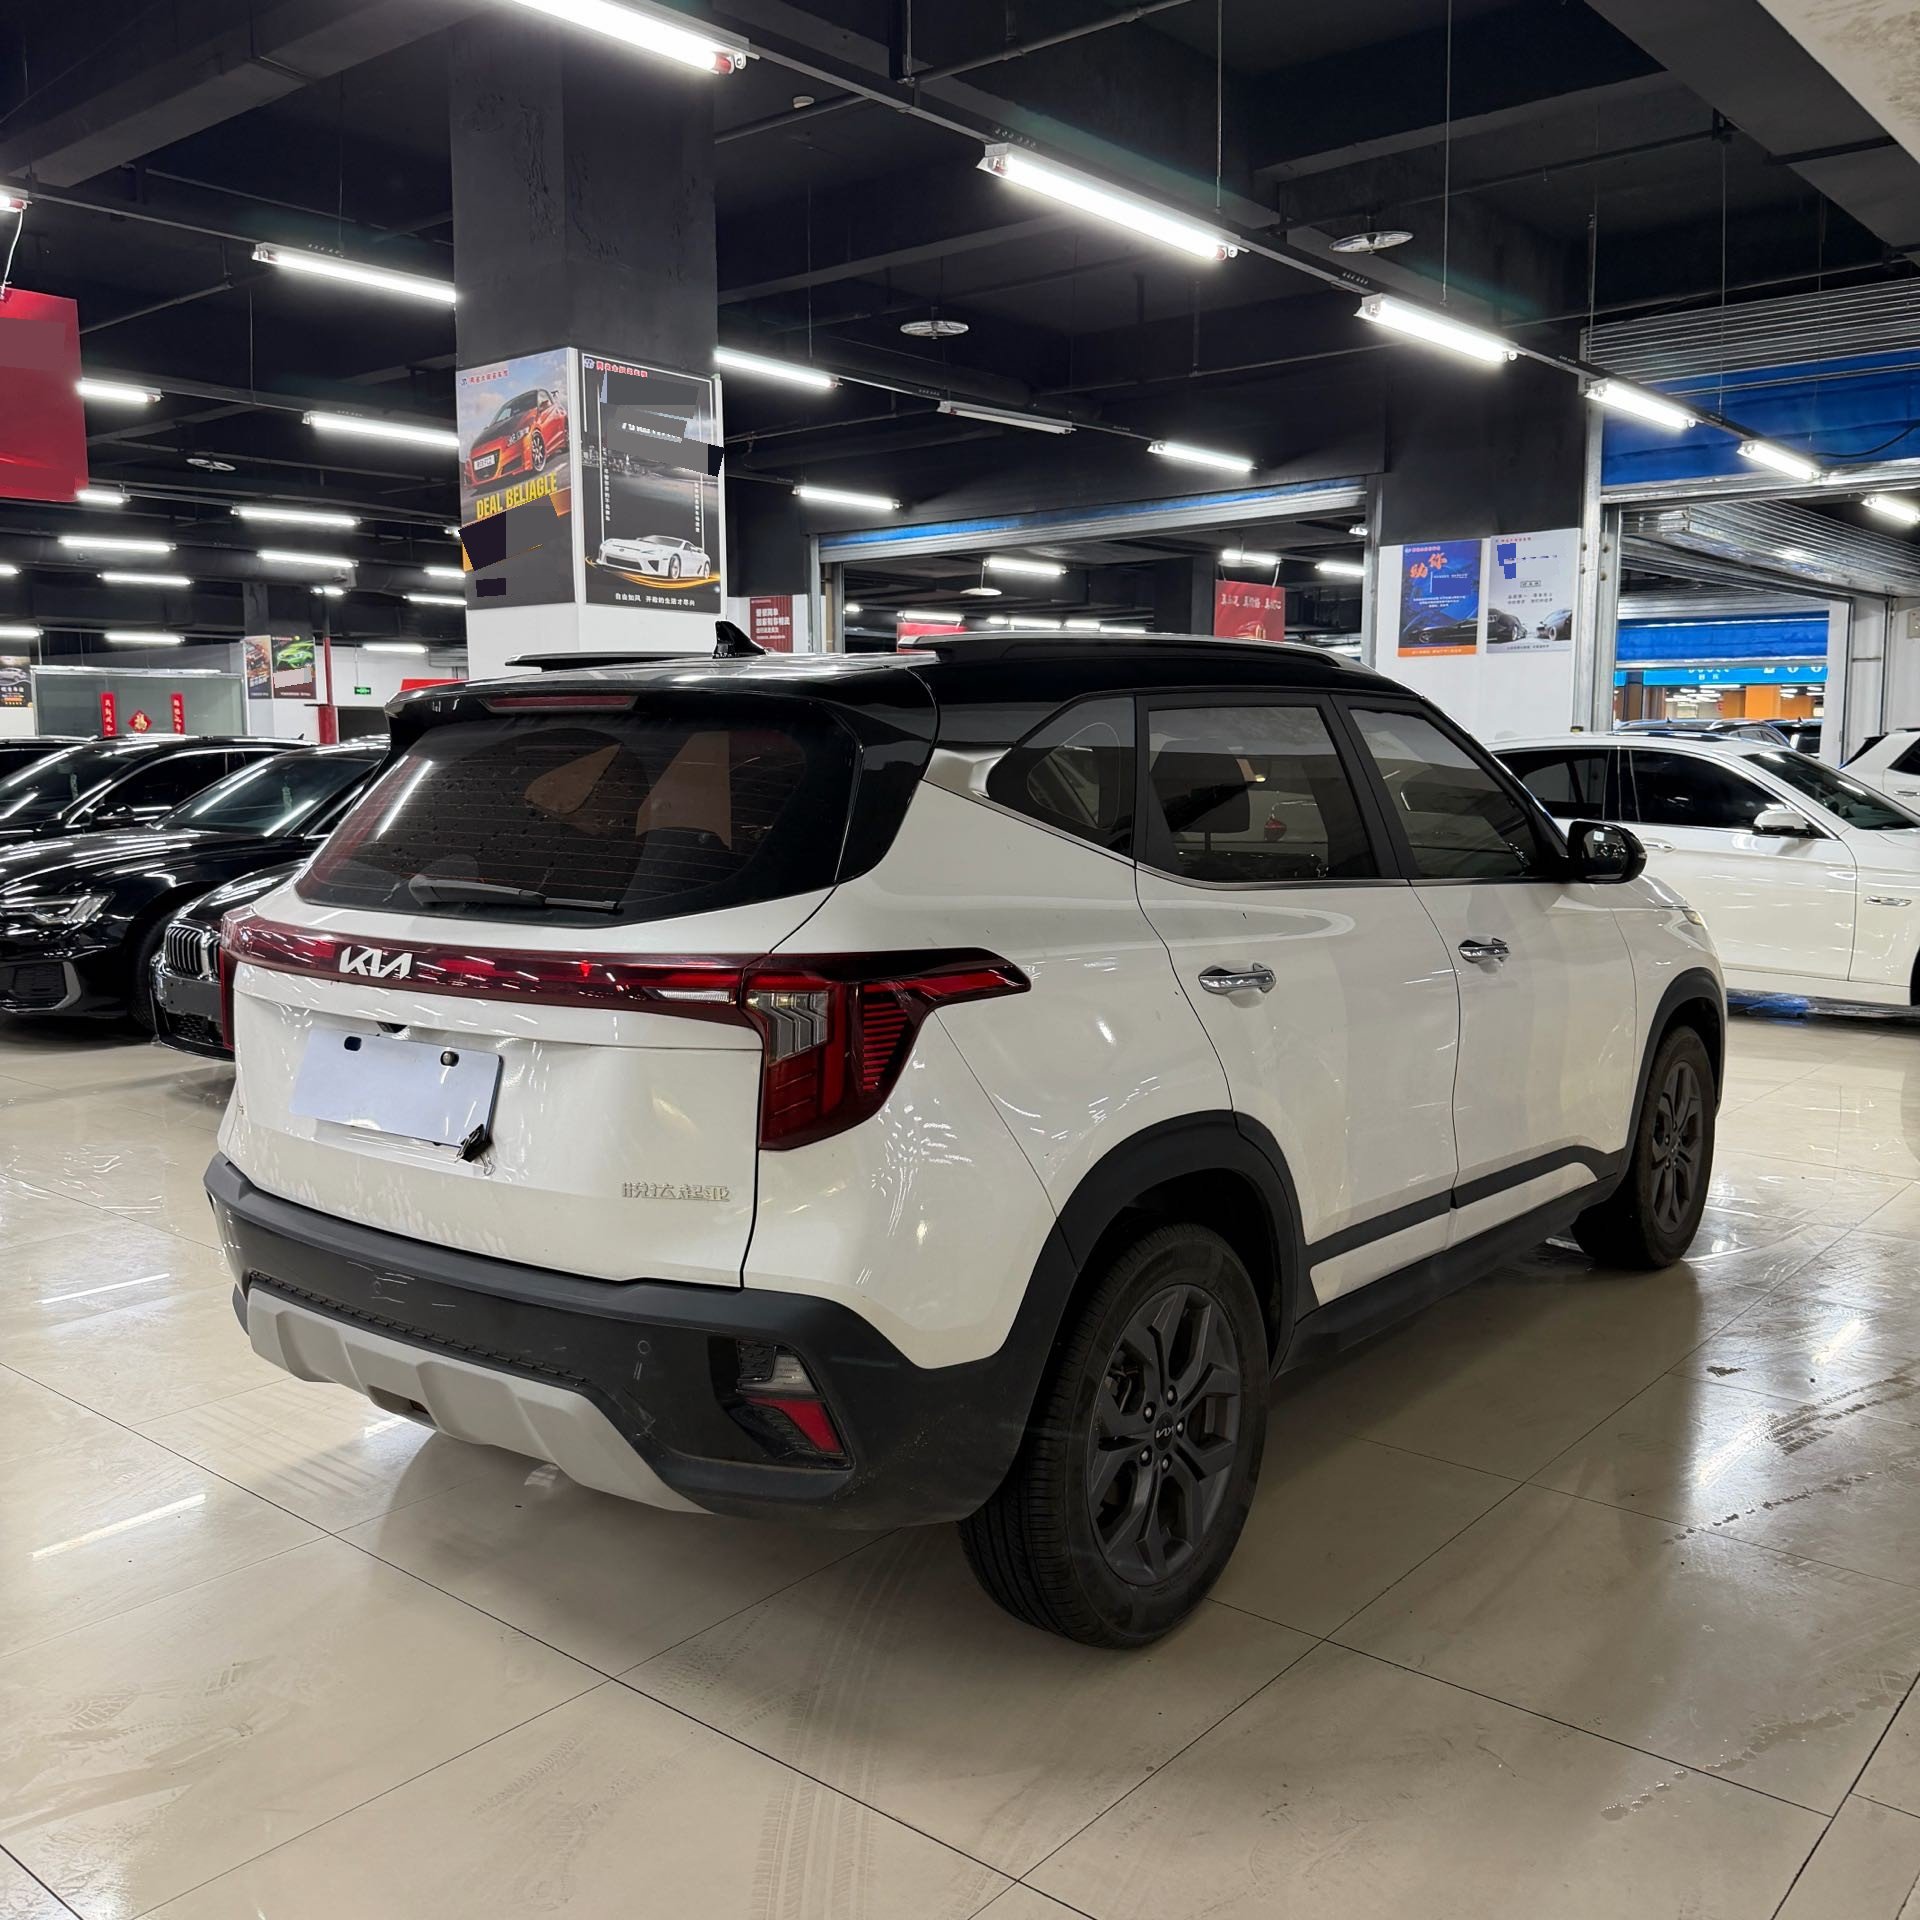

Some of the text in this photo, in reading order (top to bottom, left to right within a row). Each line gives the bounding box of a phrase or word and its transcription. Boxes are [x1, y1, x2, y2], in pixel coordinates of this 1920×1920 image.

[476, 493, 503, 520] DEAL
[134, 712, 148, 731] 福
[339, 945, 413, 980] KIA
[622, 1182, 730, 1202] 悦达起亚
